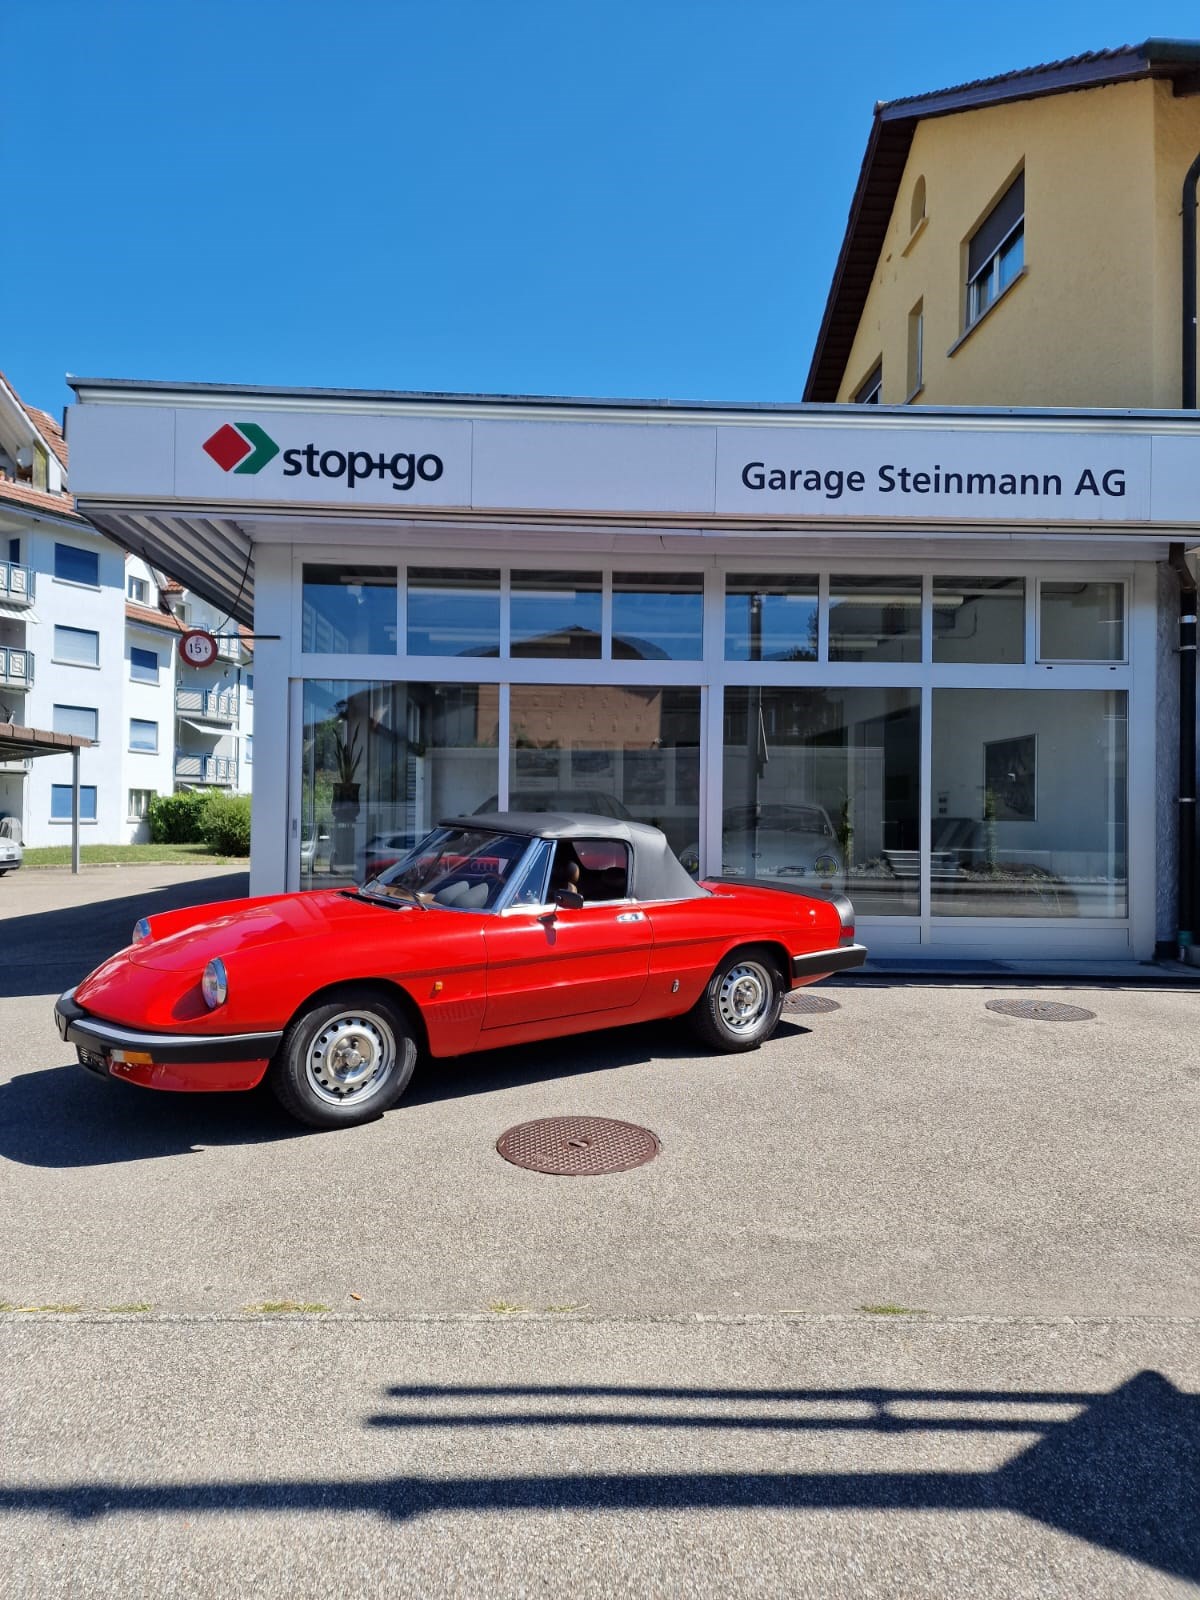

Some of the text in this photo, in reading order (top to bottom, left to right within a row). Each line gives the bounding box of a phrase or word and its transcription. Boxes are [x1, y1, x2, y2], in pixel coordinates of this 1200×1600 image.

[283, 443, 444, 491] stop+go
[742, 462, 1127, 500] Garage Steinmann AG
